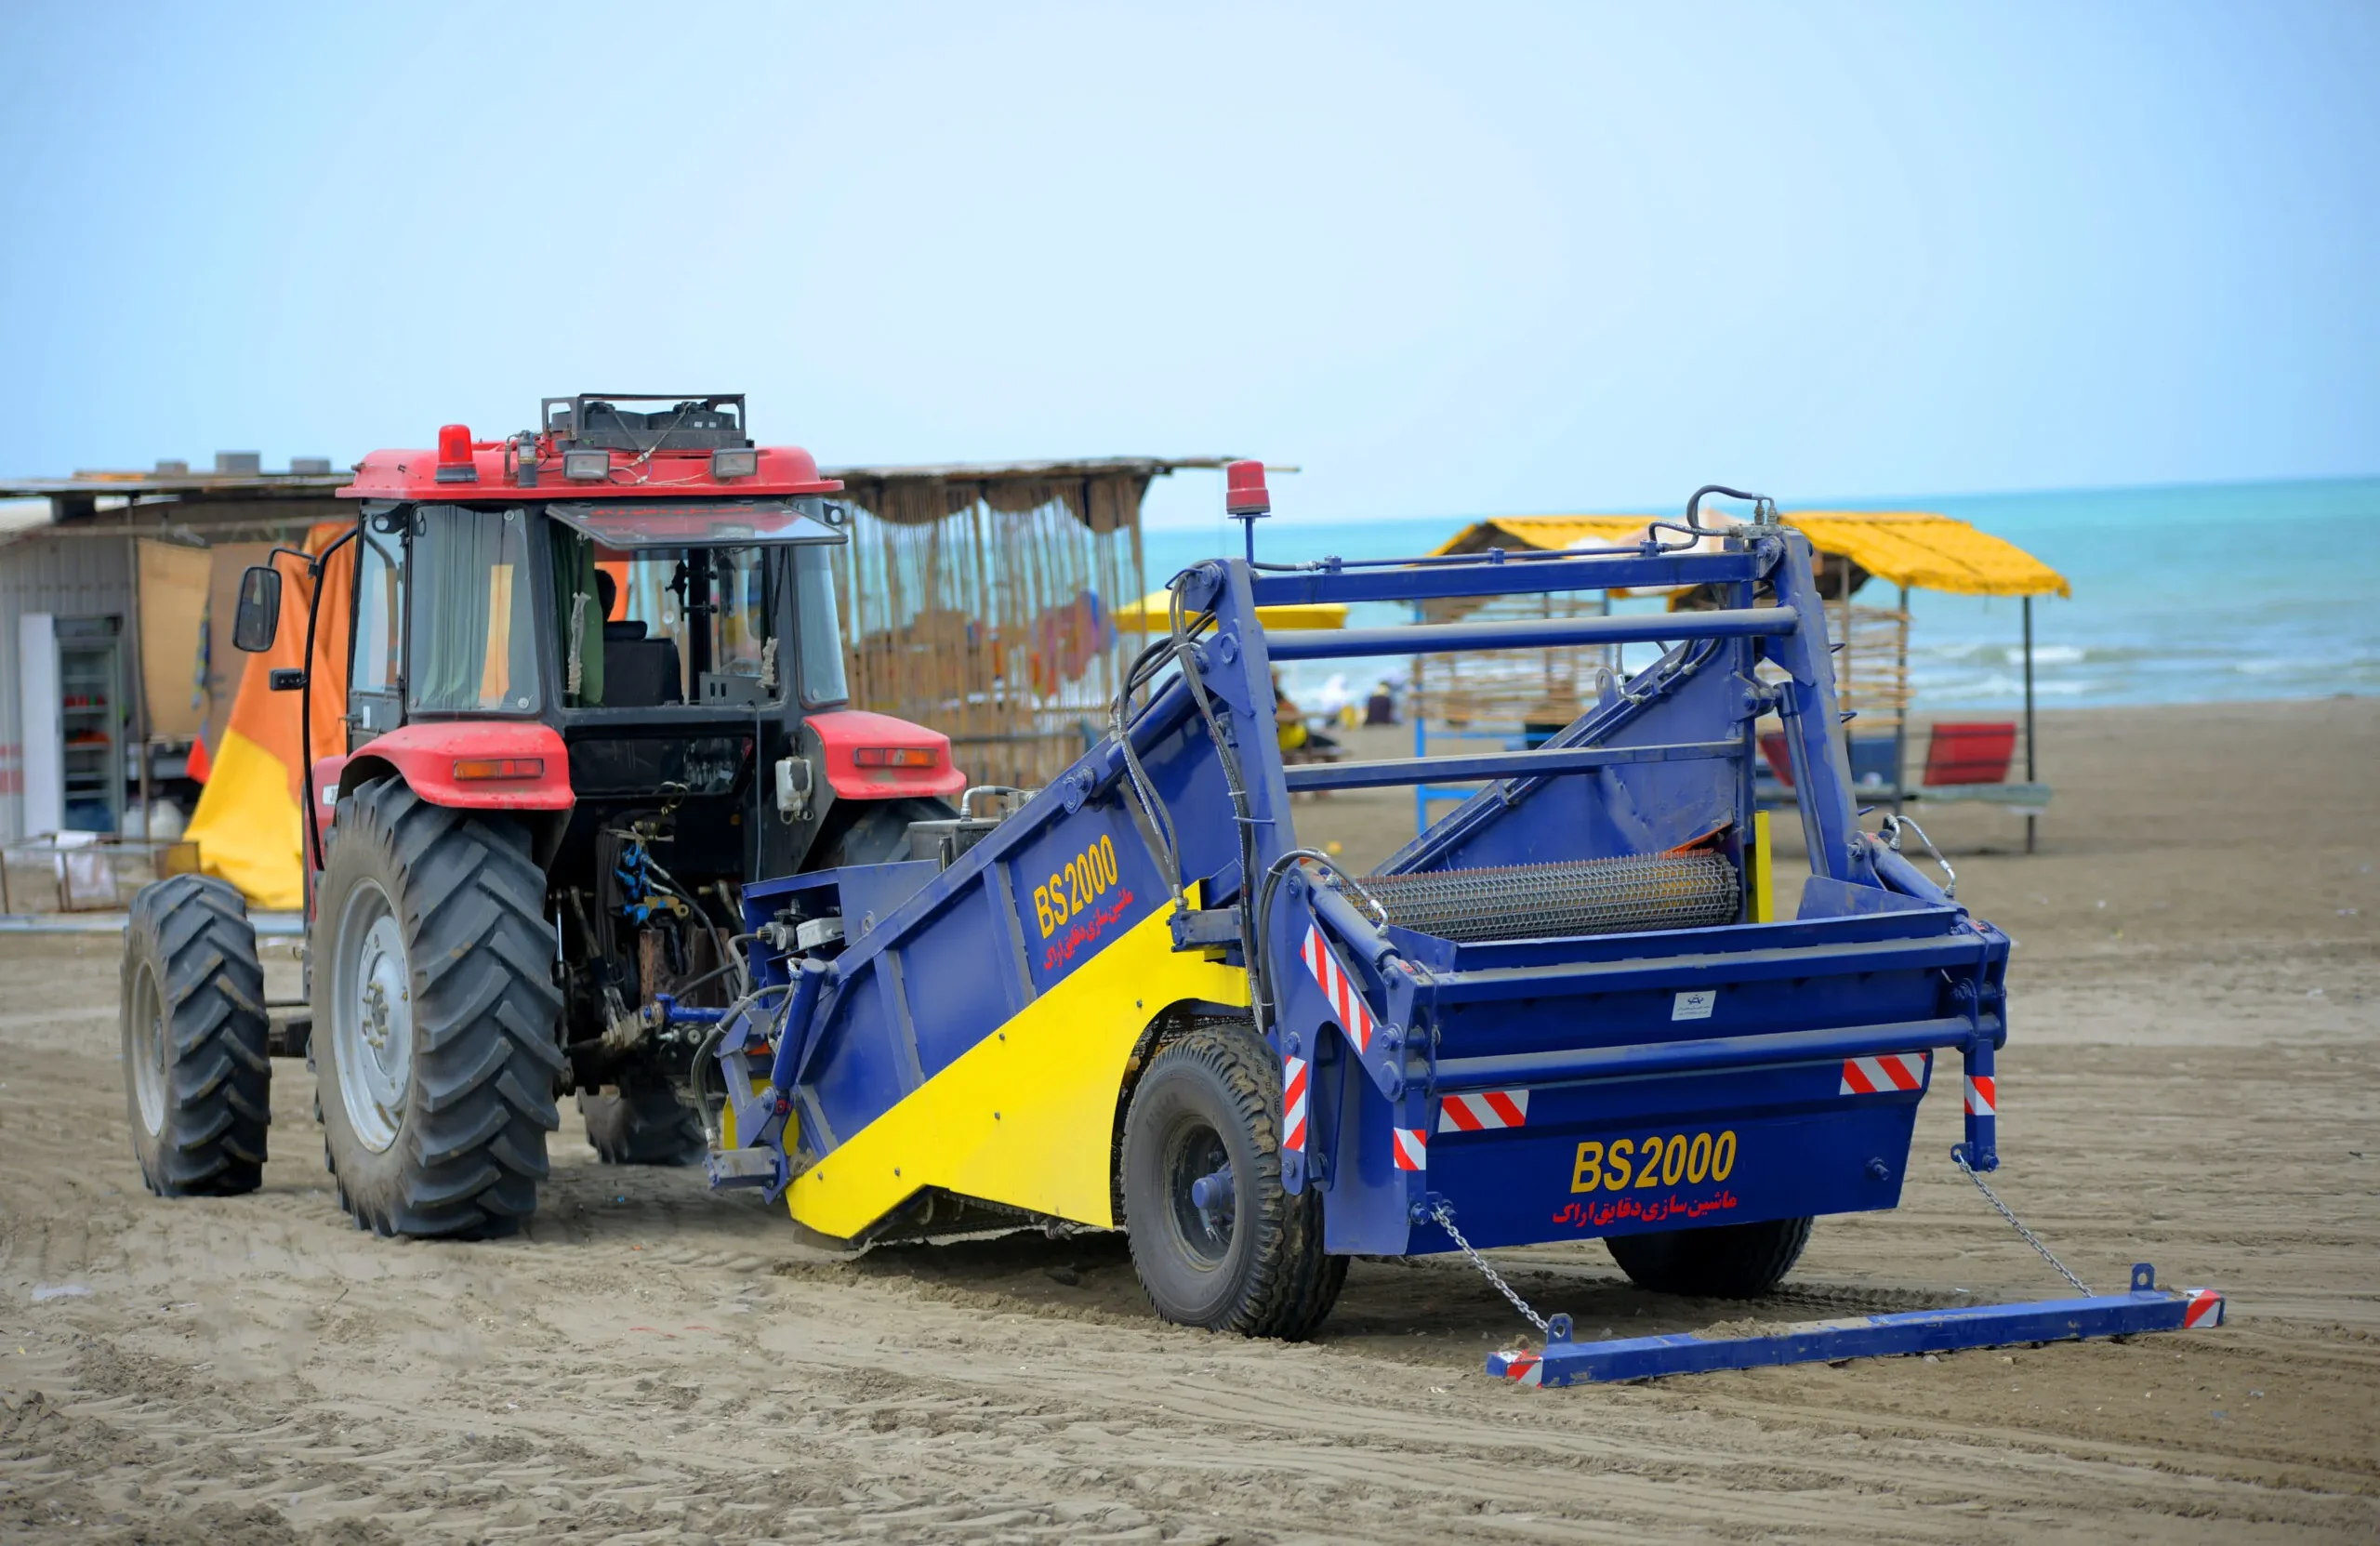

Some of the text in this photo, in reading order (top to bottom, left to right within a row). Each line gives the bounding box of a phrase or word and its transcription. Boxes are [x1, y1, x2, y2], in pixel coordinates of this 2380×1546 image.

[1033, 834, 1118, 939] BS2000
[1570, 1130, 1738, 1194] BS2000
[1641, 1195, 1687, 1222] سازی
[1687, 1191, 1738, 1218] ماشین
